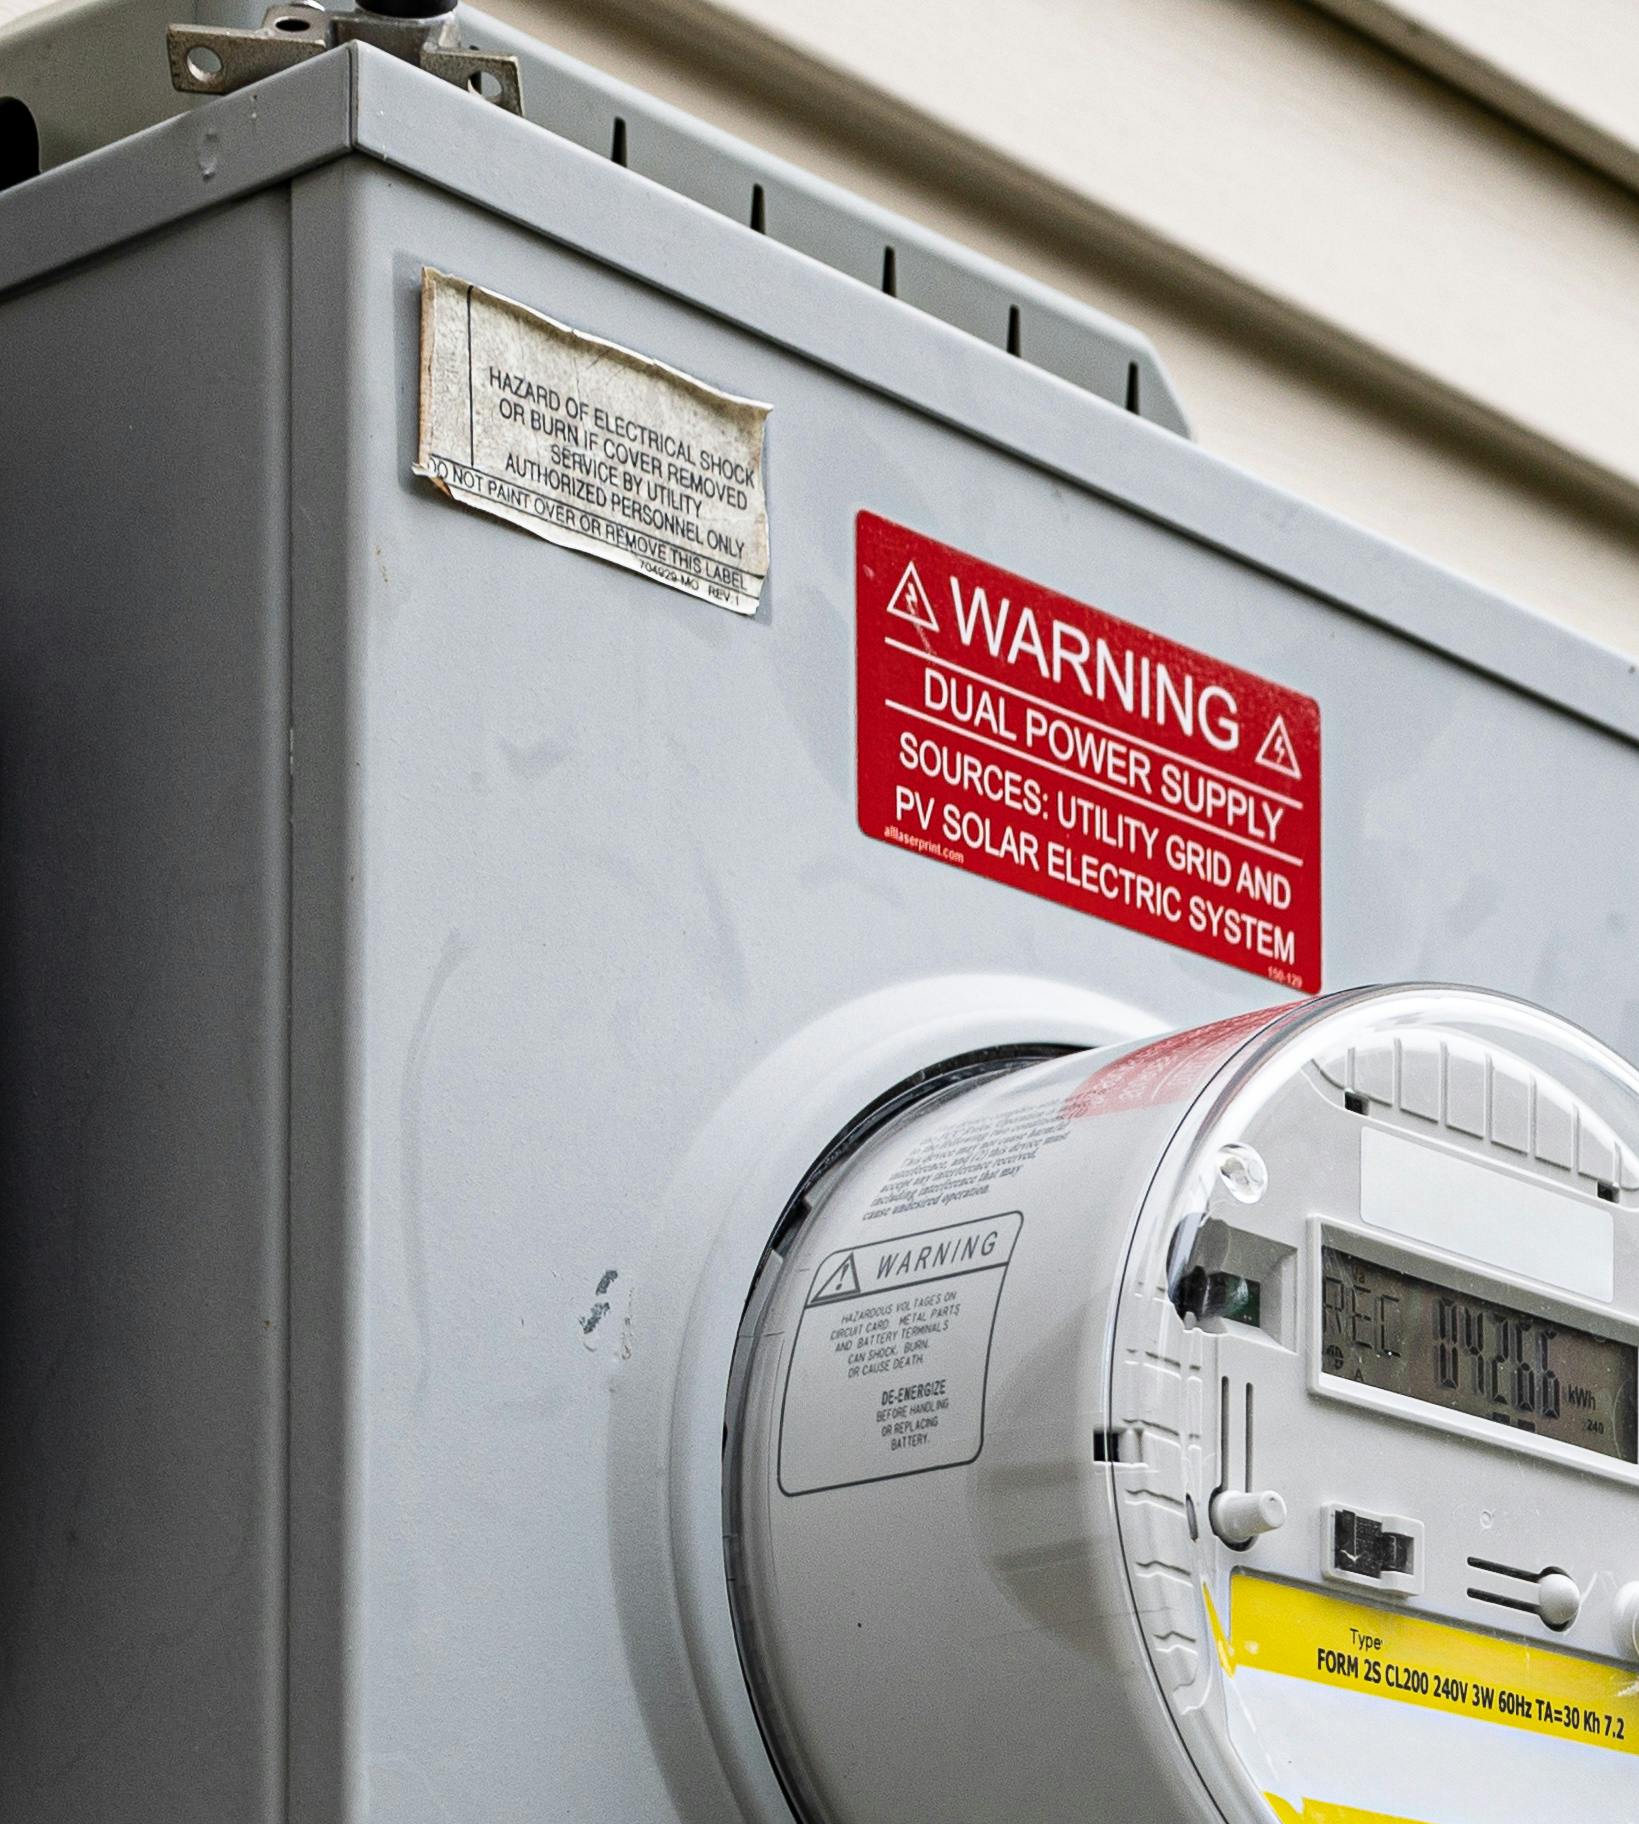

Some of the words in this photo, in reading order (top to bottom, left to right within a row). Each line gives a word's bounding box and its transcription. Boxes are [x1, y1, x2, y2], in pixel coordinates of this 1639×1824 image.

[489, 366, 560, 411] HAZARD
[565, 397, 589, 420] OF
[594, 408, 696, 466] ELECTRICAL
[700, 450, 755, 489] SHOCK
[499, 398, 525, 425] OR
[531, 410, 578, 447] BURN
[584, 430, 598, 451] IF
[603, 438, 662, 478] COVER
[668, 463, 747, 510] REMOVED
[551, 444, 619, 487] SERVICE
[623, 472, 642, 495] BY
[648, 481, 702, 518] UTILITY
[453, 465, 483, 492] NOT
[488, 480, 529, 509] PAINT
[534, 498, 575, 526] OVER
[580, 515, 601, 536] OR
[606, 524, 666, 561] REMOVE
[671, 545, 701, 575] THIS
[706, 562, 747, 590] LABEL
[506, 453, 607, 507] AUTHORIZED
[612, 492, 703, 545] PERSONNEL
[707, 530, 745, 559] ONLY
[950, 577, 1239, 750] WARNING
[925, 668, 1017, 741] DUAL
[1026, 710, 1152, 795] POWER
[1161, 765, 1283, 843] SUPPLY
[900, 731, 1048, 820] SOURCES:
[1057, 791, 1158, 859] UTILITY
[1165, 835, 1231, 888] GRID
[1236, 861, 1291, 910] AND
[896, 786, 935, 830] PV
[943, 804, 1039, 871] SOLAR
[1048, 846, 1181, 922] ELECTRIC
[1189, 895, 1294, 965] SYSTEM
[877, 1231, 998, 1280] WARNING
[830, 1323, 863, 1341] CIRCUIT
[899, 1312, 926, 1327] METAL
[930, 1304, 961, 1319] PARTS
[841, 1304, 893, 1325] HAZARDOUS
[944, 1291, 957, 1303] ON
[835, 1341, 853, 1352] AND
[857, 1330, 898, 1349] BATTERY
[848, 1352, 865, 1365] CAN
[848, 1366, 860, 1378] OR
[862, 1360, 891, 1376] CAUSE
[881, 1379, 946, 1406] DE-ENERGIZE
[876, 1405, 908, 1422] BEFORE
[909, 1399, 949, 1415] HANDLING
[1568, 1384, 1596, 1411] kWh
[881, 1423, 892, 1437] OR
[894, 1416, 938, 1434] REPLACING
[1350, 1628, 1382, 1651] Type
[1317, 1648, 1359, 1679] FORM
[1364, 1659, 1381, 1683] 2S
[1385, 1664, 1428, 1695] CL200
[1433, 1675, 1468, 1704] 240V
[1472, 1684, 1494, 1708] 3W
[1499, 1691, 1532, 1719] 60Hz
[1536, 1699, 1580, 1730] TA=30
[1584, 1710, 1600, 1734] Kh
[1604, 1717, 1625, 1740] 7.2
